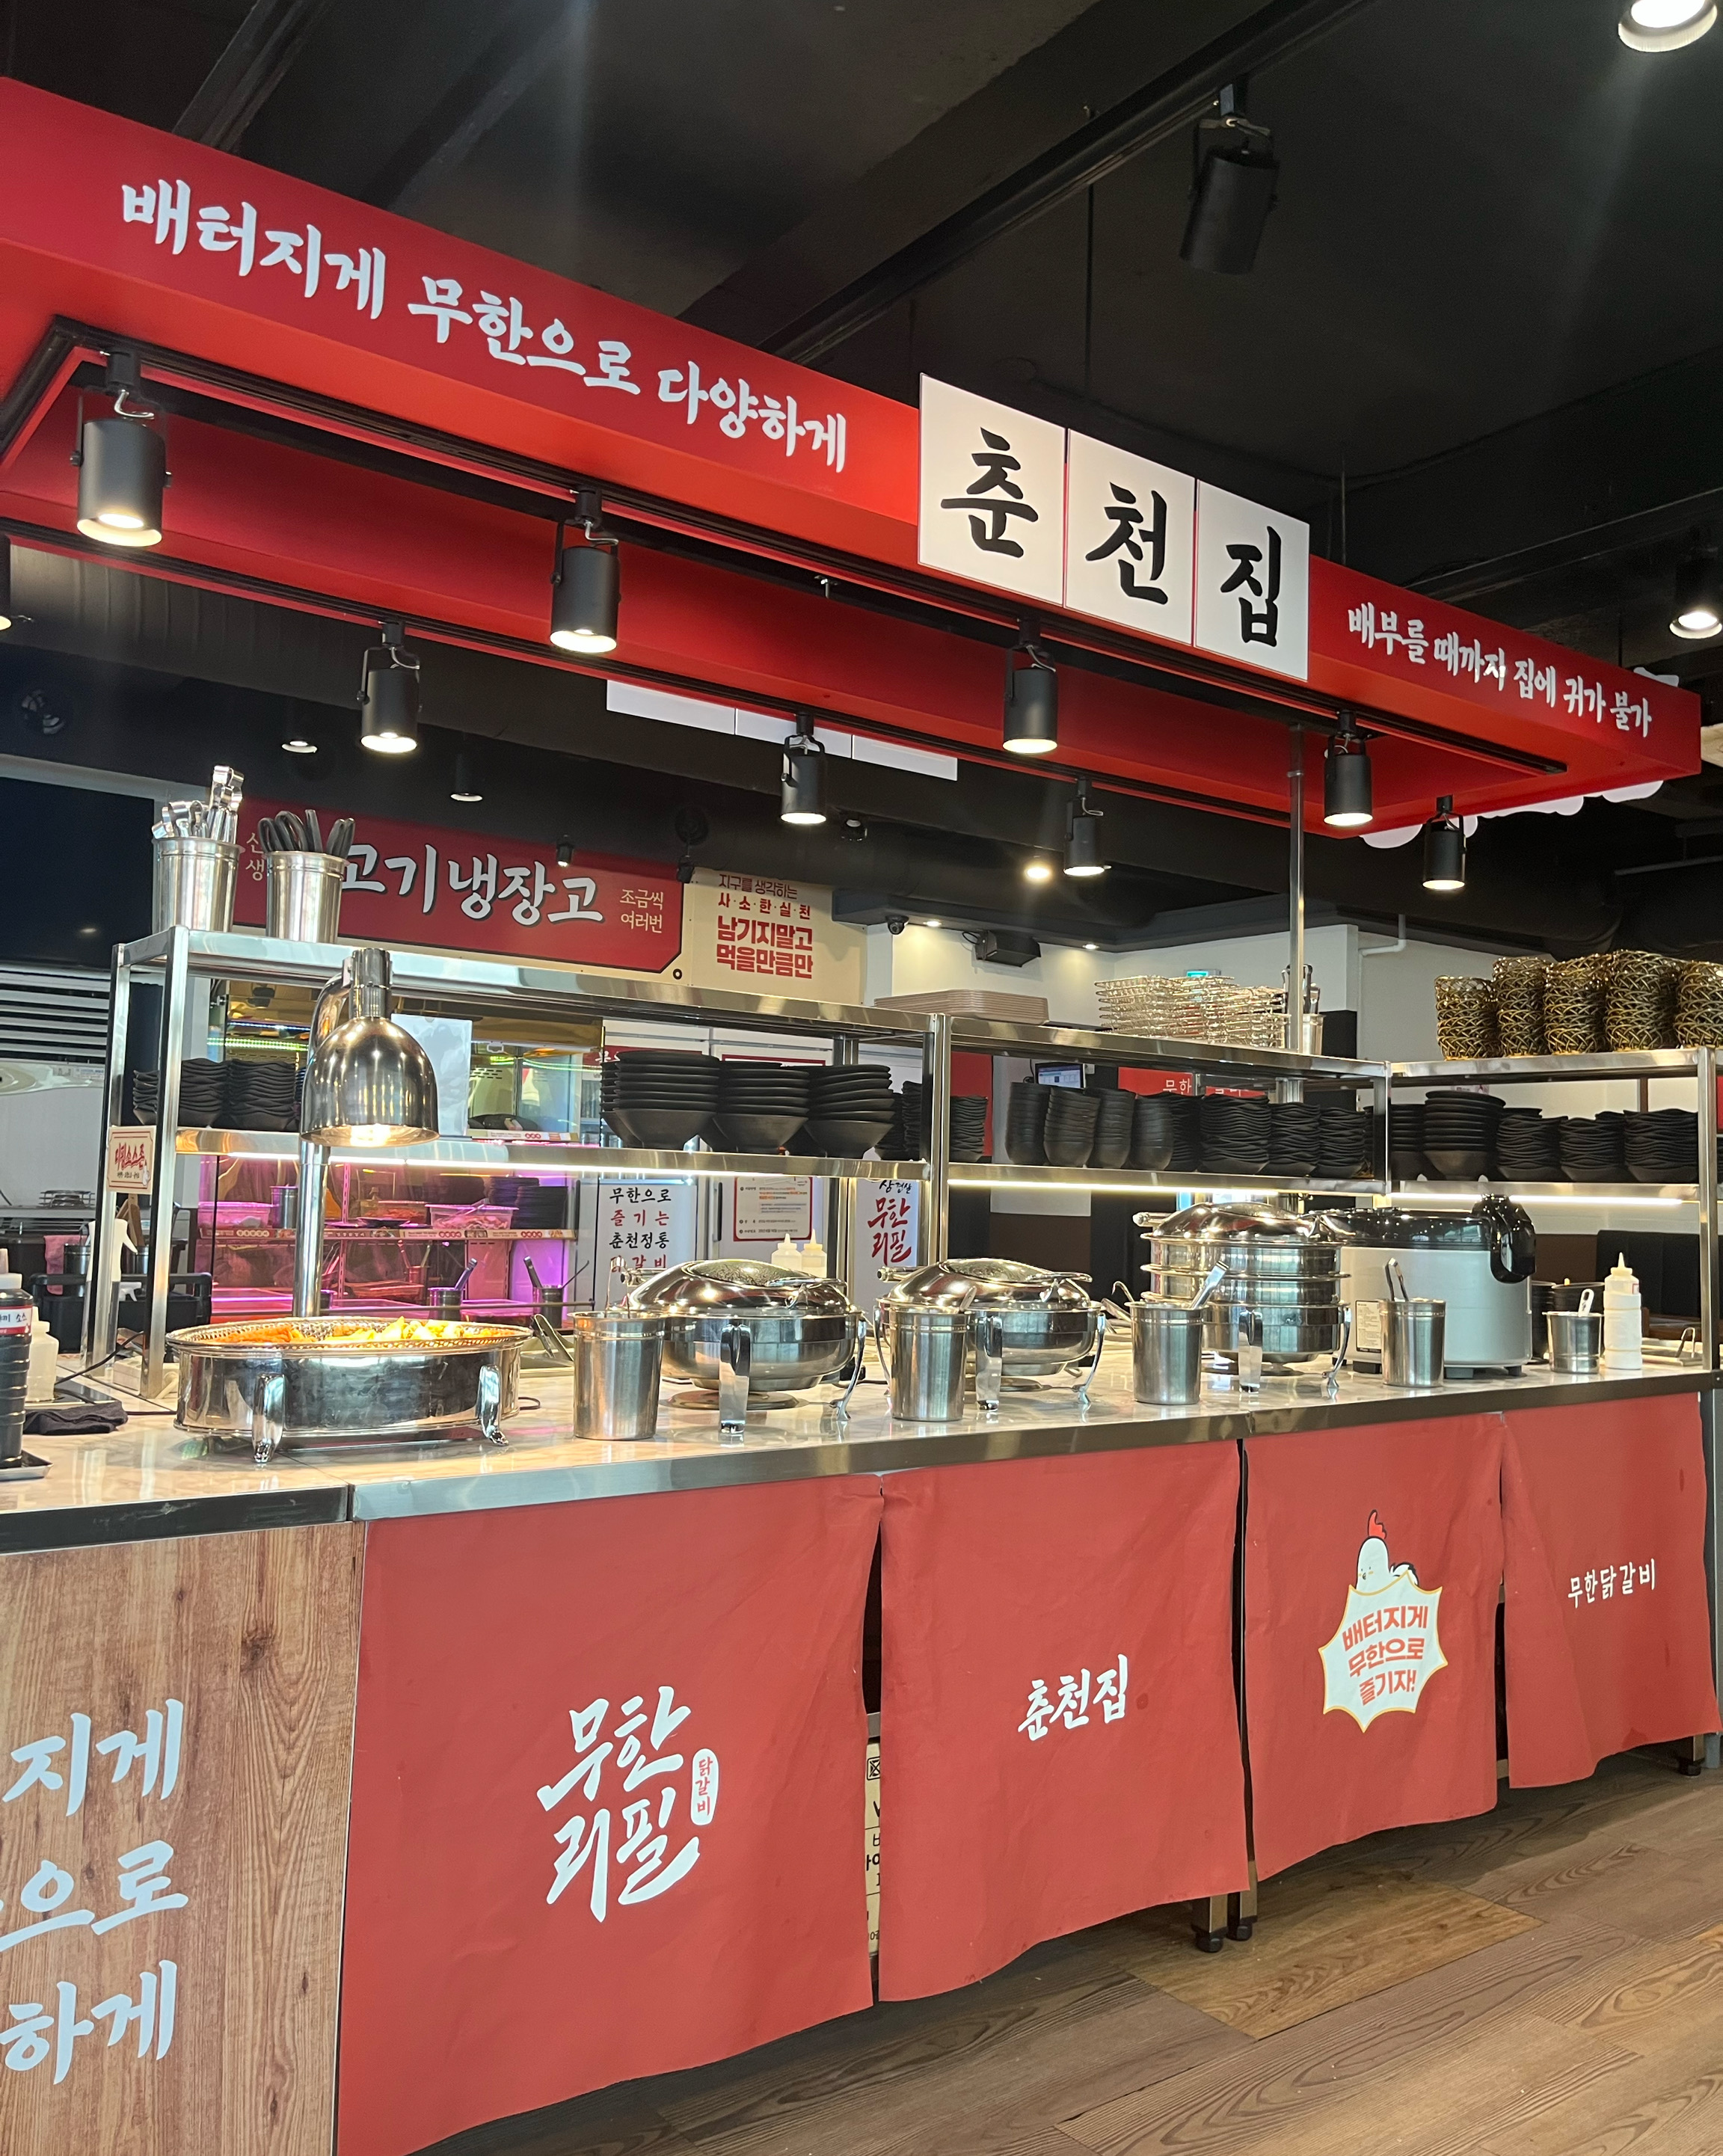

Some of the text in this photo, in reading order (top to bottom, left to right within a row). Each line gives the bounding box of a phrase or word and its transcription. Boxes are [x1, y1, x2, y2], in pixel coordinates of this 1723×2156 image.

[122, 179, 847, 473] 배터지게 무한으로 다양하게
[940, 426, 1282, 648] 춘천집
[1348, 602, 1653, 737] 배부를 때까지 집에 귀가 불가
[619, 888, 664, 910] 조금씩
[718, 873, 798, 900] 지구를 생각하는
[620, 910, 663, 933] 여러번
[717, 915, 813, 952] 남기지말고
[716, 943, 813, 979] 먹을만큼만
[609, 1187, 672, 1205] 무한으로
[867, 1197, 911, 1229] 무한
[609, 1232, 670, 1250] 춘천정통
[871, 1229, 912, 1266] 리필
[1342, 1605, 1429, 1652] 배터지게
[1348, 1637, 1425, 1677] 무한으로
[1017, 1653, 1128, 1742] 춘천집
[536, 1685, 692, 1811] 무한
[695, 1756, 713, 1816] 닭갈비
[546, 1786, 701, 1923] 리필
